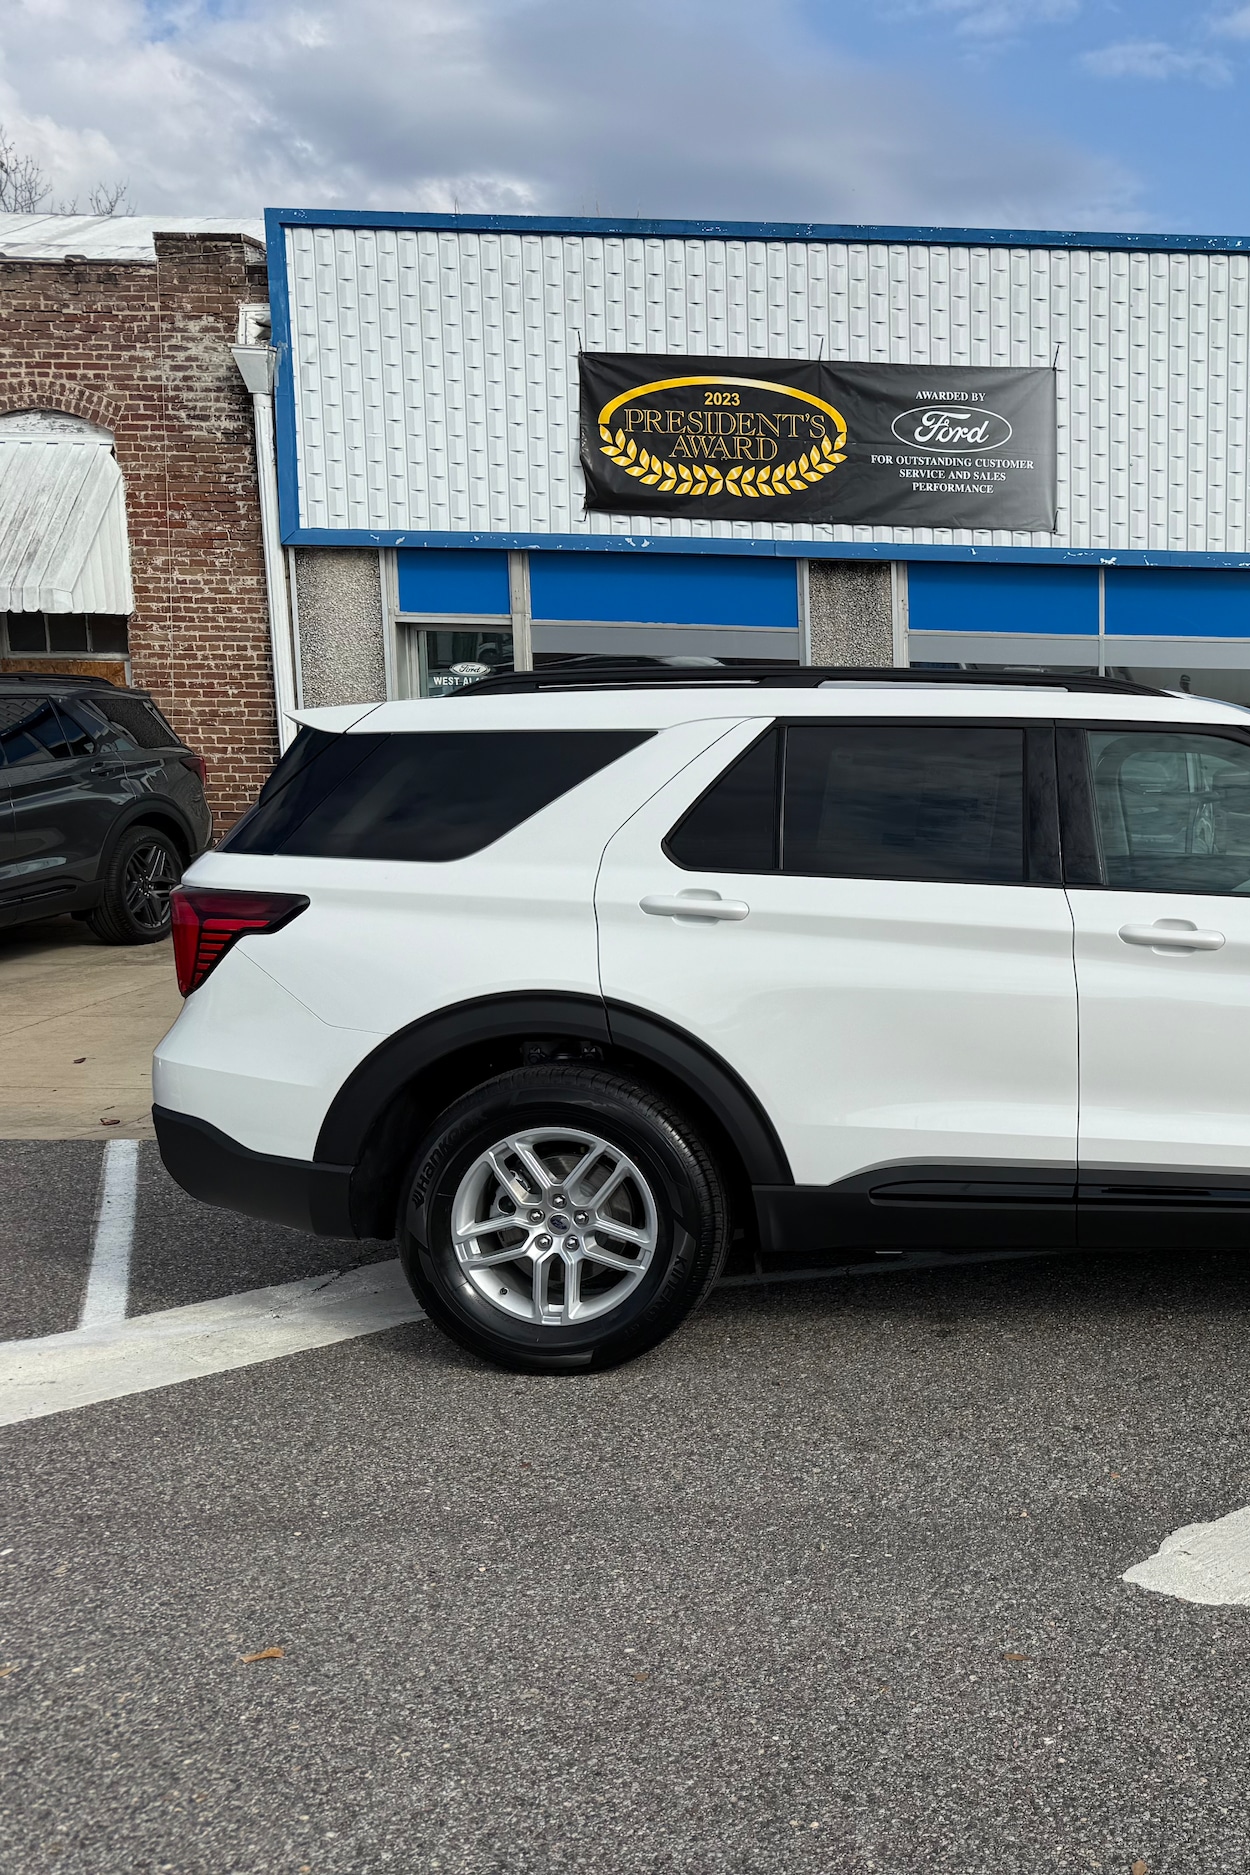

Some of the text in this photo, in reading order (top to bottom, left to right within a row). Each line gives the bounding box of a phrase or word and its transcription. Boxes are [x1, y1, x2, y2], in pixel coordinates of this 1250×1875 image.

[703, 391, 741, 407] 2023
[915, 391, 986, 402] AWARDED BY
[624, 408, 827, 439] PRESIDENT'S
[914, 410, 990, 443] Ford
[668, 435, 779, 462] AWARD
[870, 454, 1034, 470] FOR OUTSTANDING CUSTOMER
[899, 468, 1006, 482] SERVICE AND SALES
[912, 482, 994, 494] PERFORMANCE
[433, 676, 460, 686] WEST
